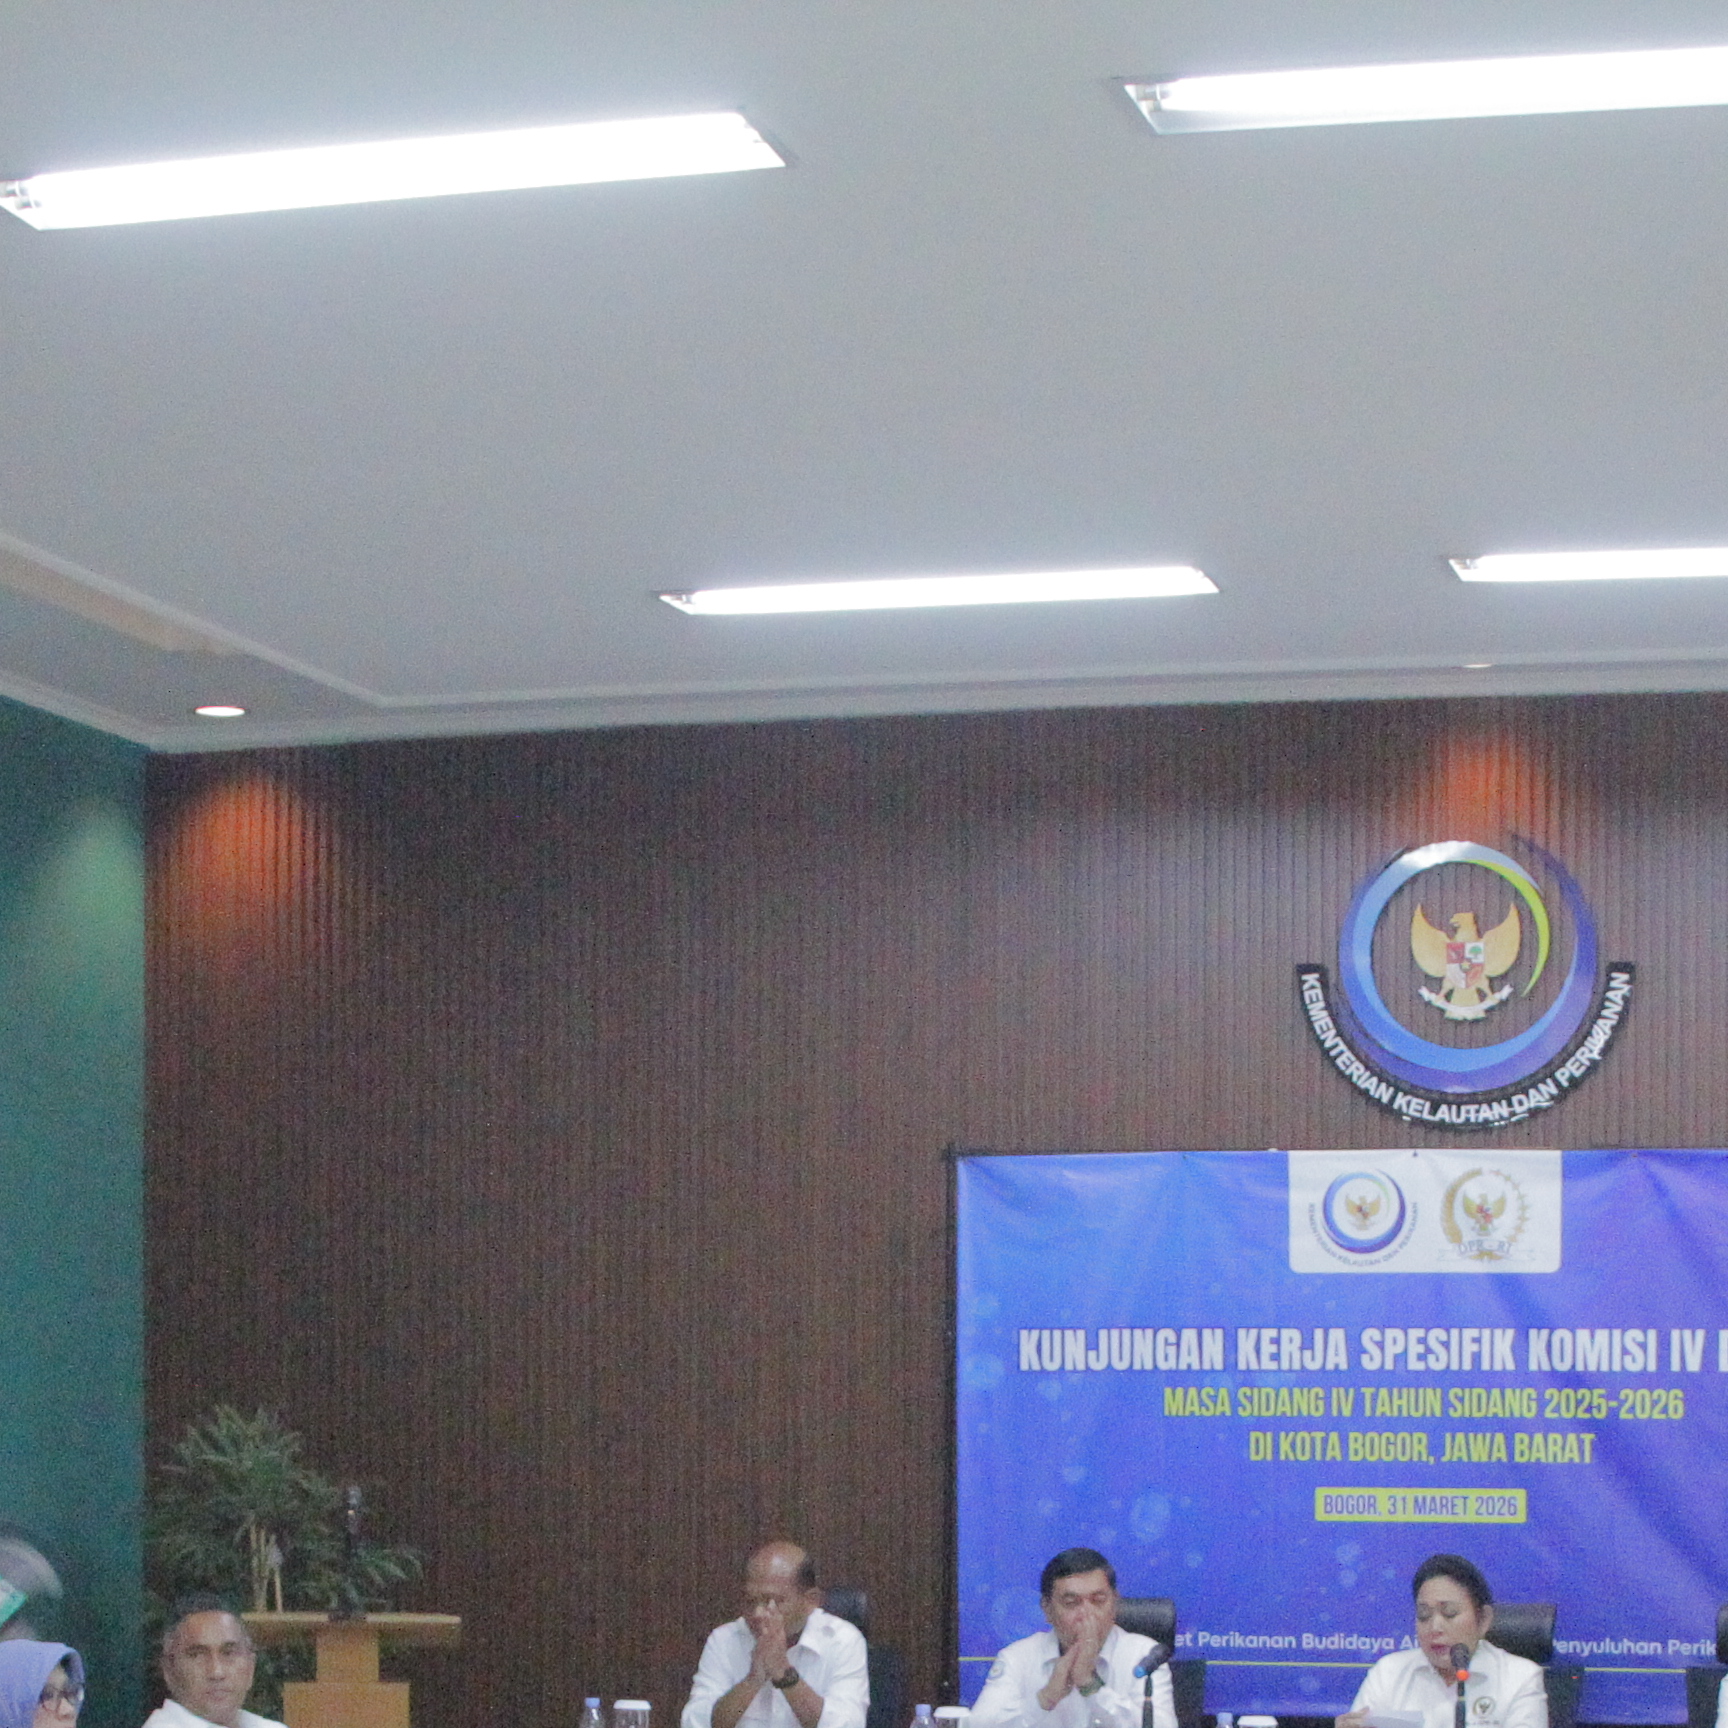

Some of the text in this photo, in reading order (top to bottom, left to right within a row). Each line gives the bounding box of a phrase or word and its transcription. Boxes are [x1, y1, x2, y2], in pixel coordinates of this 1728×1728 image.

[1301, 972, 1395, 1104] KEMENTERIAN
[1392, 1091, 1510, 1124] KELAUTAN
[1511, 1077, 1560, 1112] DAN
[1019, 1327, 1225, 1371] KUNJUNGAN
[1237, 1327, 1348, 1371] KERJA
[1360, 1327, 1516, 1372] SPESIFIK
[1528, 1328, 1658, 1373] KOMISI
[1671, 1328, 1706, 1373] IV
[1163, 1386, 1685, 1419] MASA SIDANG IV TAHUN SIDANG 2025-2026
[1249, 1431, 1596, 1465] DI KOTA BOGOR, JAWA BARAT
[1323, 1494, 1519, 1517] BOGOR, 31 MARET 2026
[1174, 1631, 1420, 1652] et Perikanan Budidaya Ai
[1667, 1639, 1717, 1657] Perik
